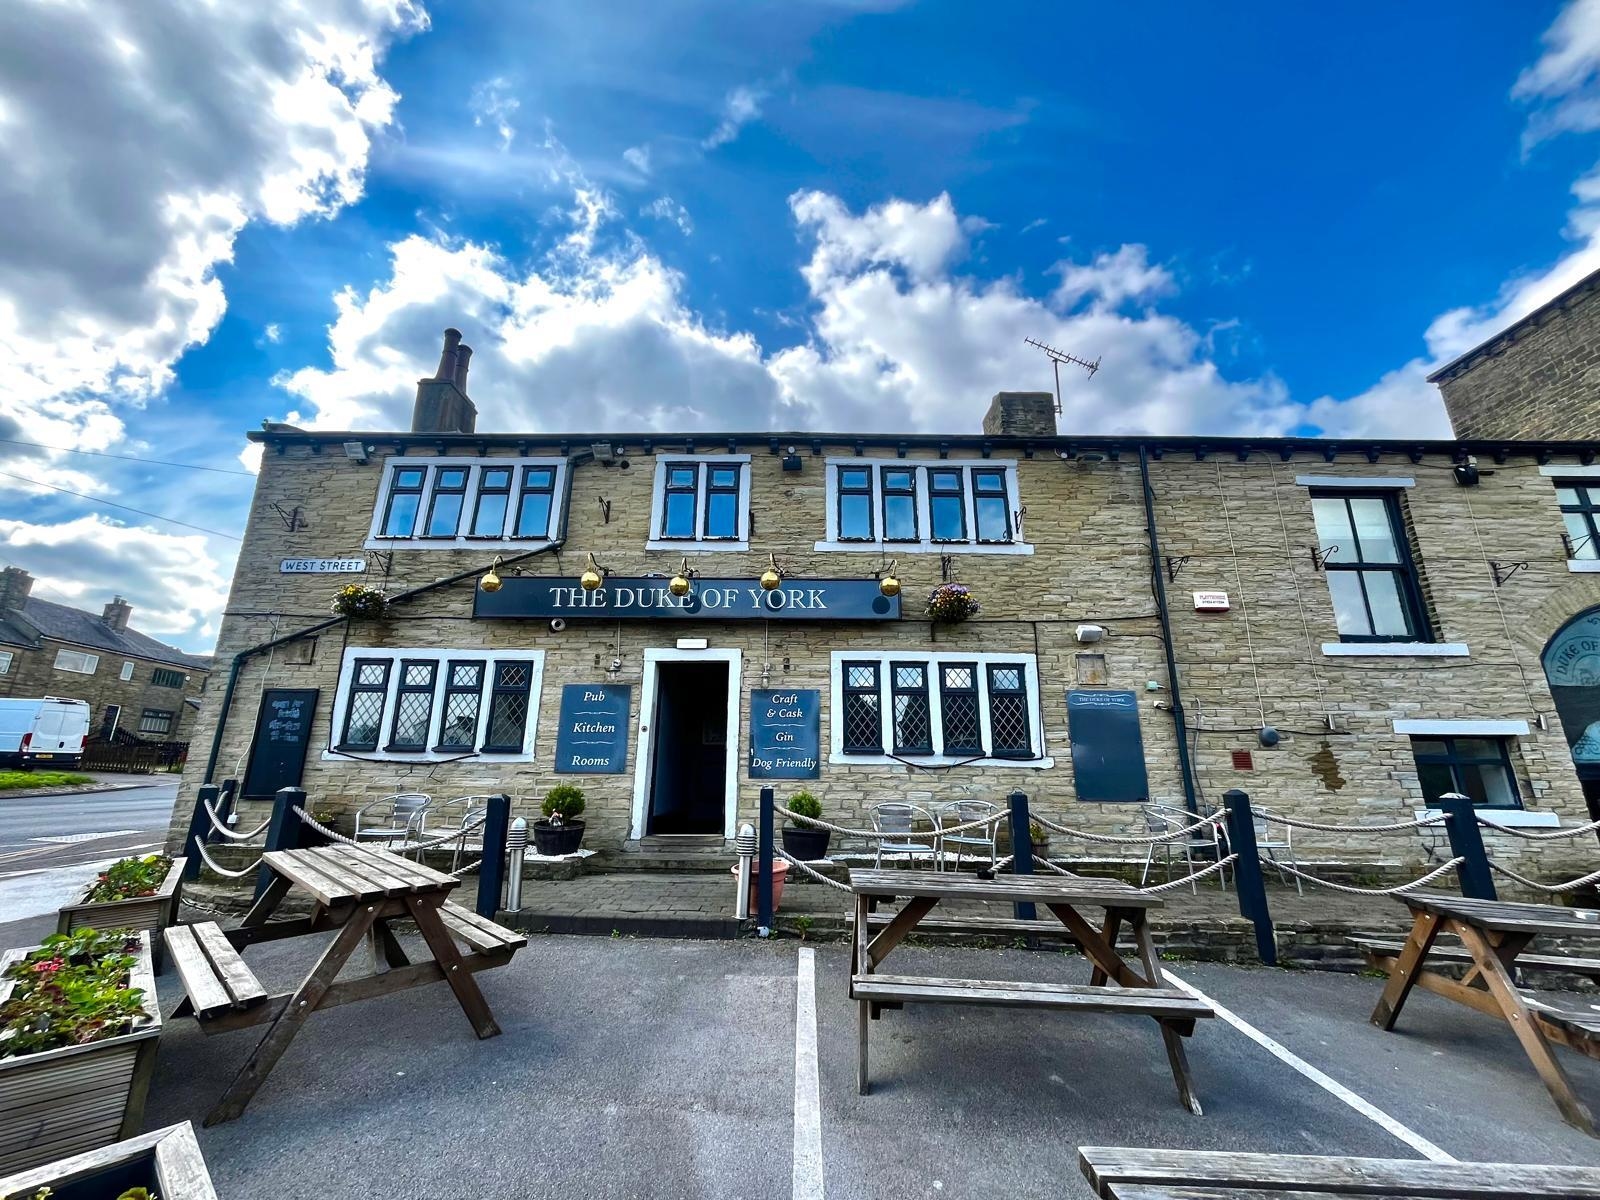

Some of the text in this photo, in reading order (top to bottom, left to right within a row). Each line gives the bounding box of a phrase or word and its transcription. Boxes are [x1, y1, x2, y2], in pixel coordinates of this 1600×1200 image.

[285, 561, 361, 571] WEST STREET
[550, 587, 828, 609] THE DUKE OF YORK
[1556, 640, 1599, 675] DUKE OF
[583, 690, 605, 702] Pub
[772, 693, 798, 706] Craft
[766, 707, 803, 718] & Cask
[573, 721, 616, 733] Kitchen
[775, 731, 794, 742] Gin
[571, 755, 610, 766] Rooms
[751, 757, 817, 770] Dog Friendly
